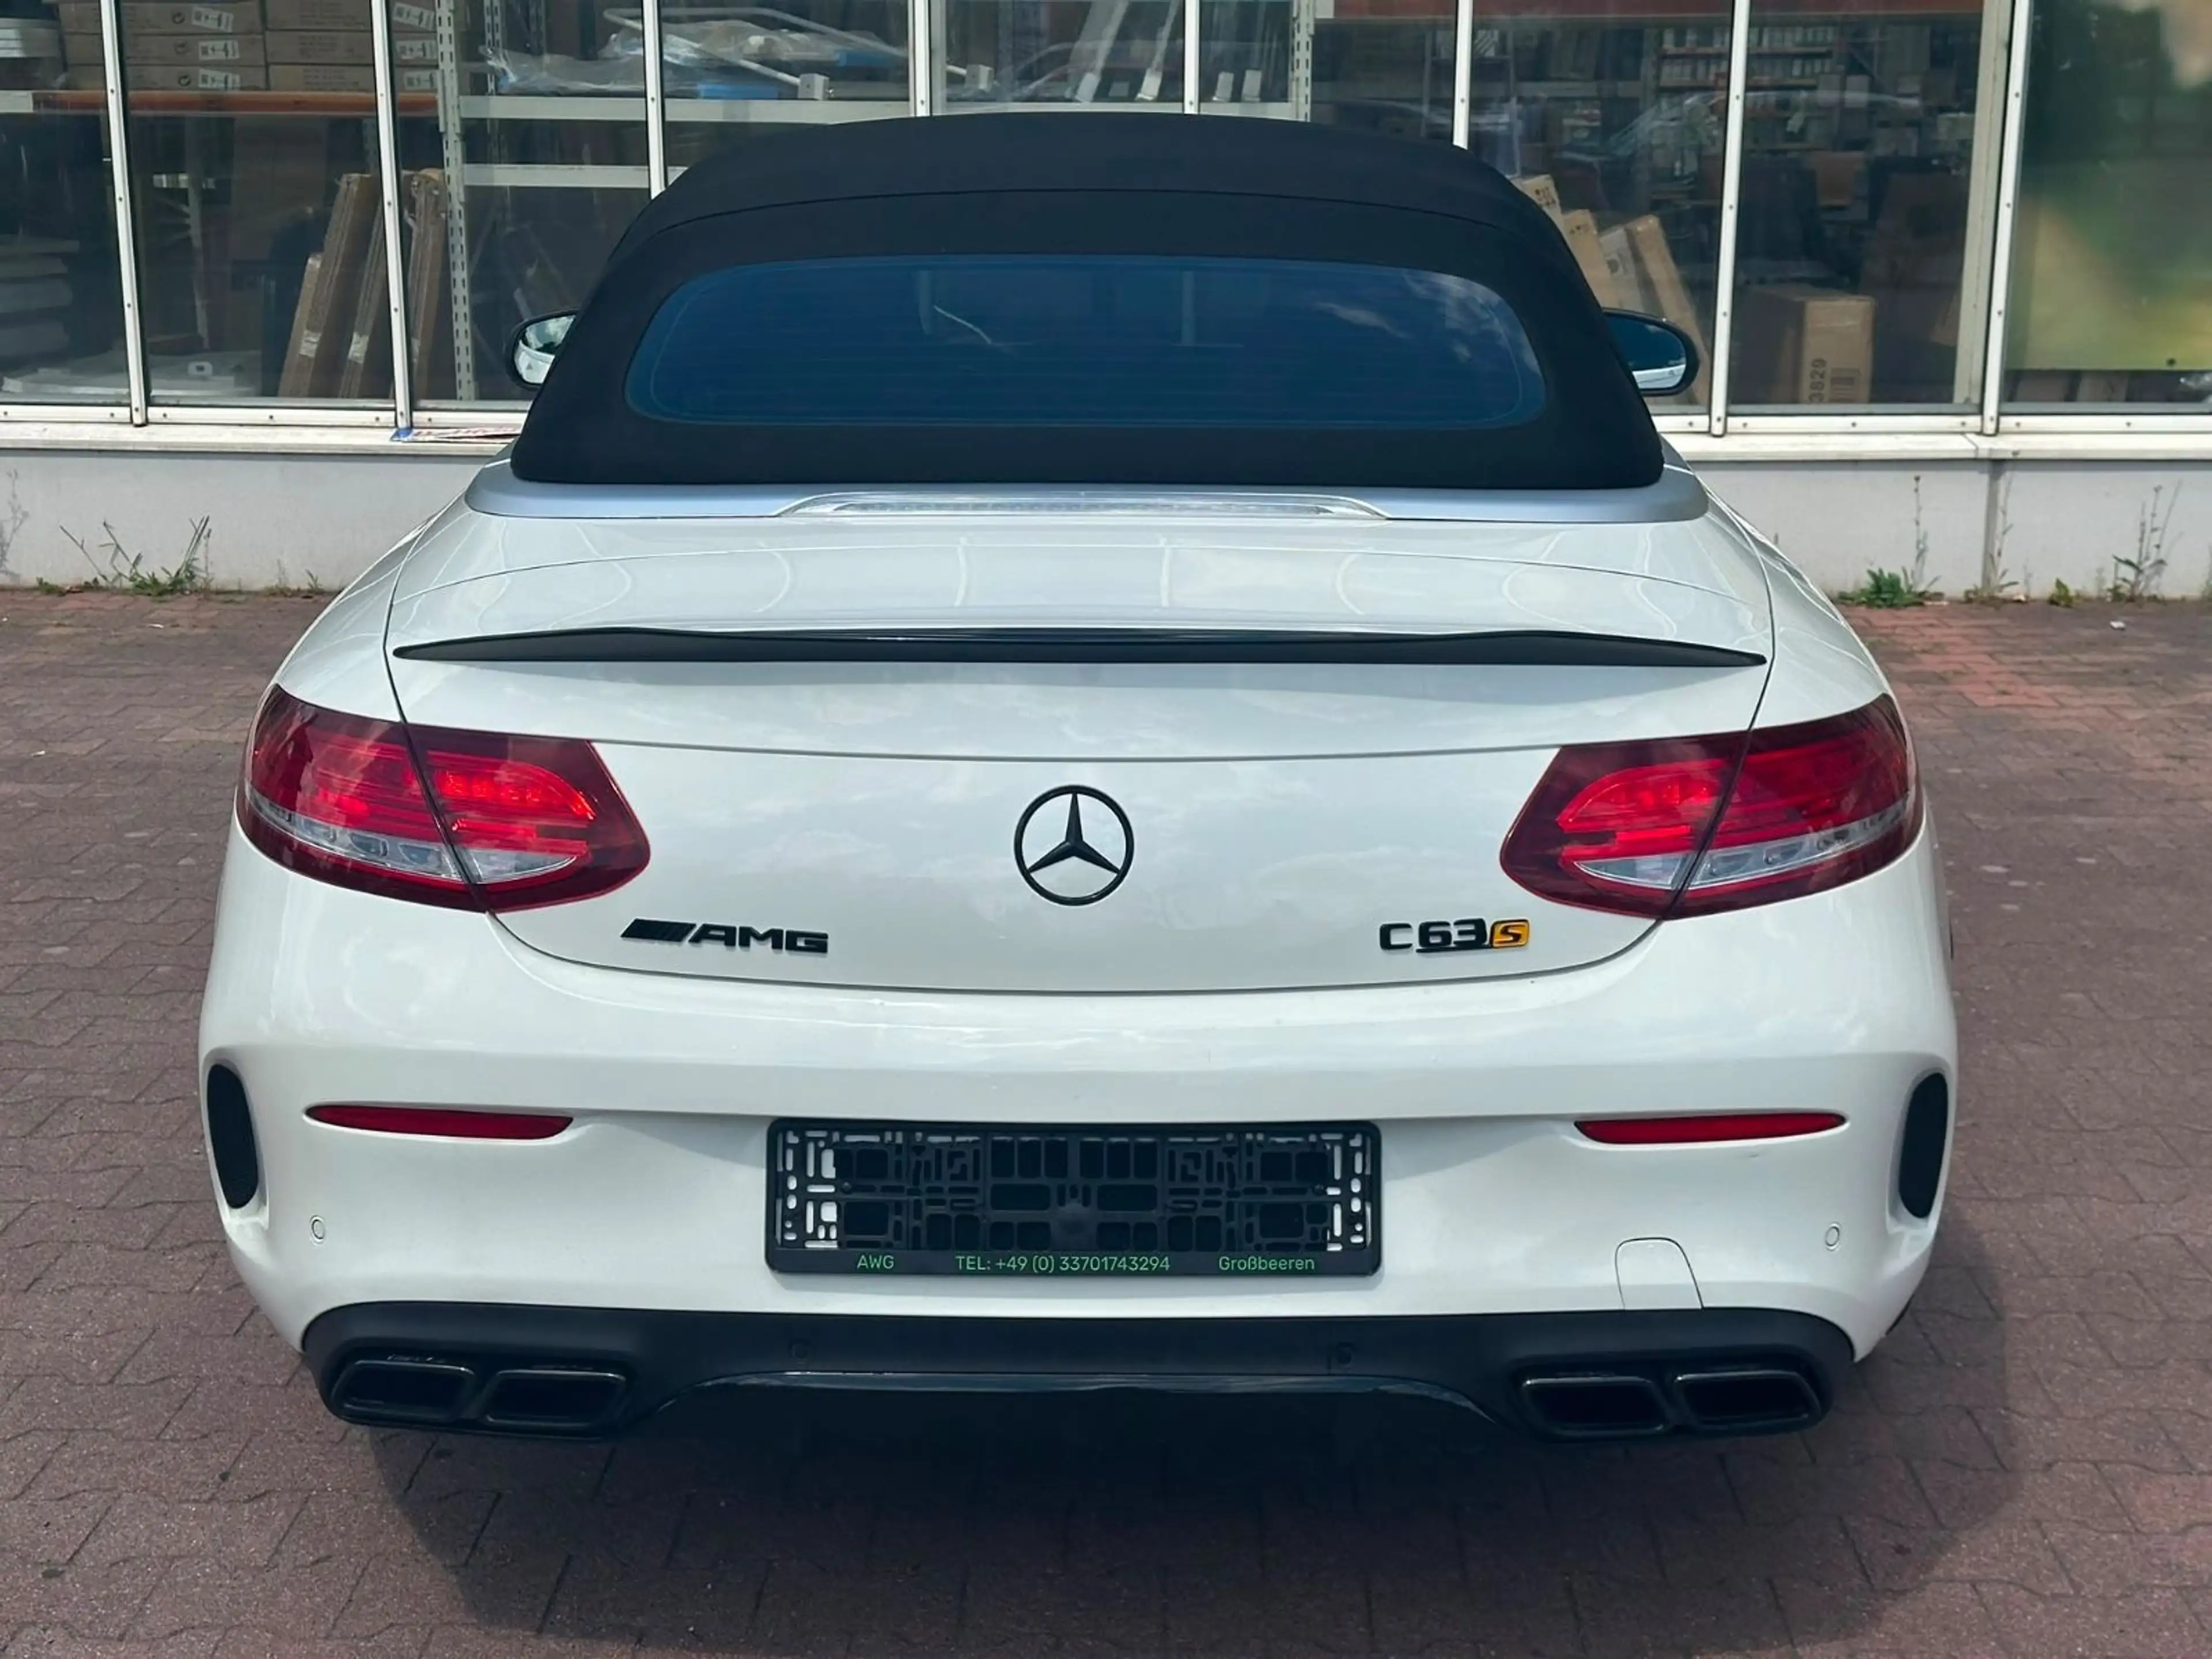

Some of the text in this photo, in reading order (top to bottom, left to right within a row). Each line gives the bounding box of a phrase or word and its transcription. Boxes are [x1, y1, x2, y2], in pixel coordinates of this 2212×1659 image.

[688, 923, 828, 953] AMG
[857, 1255, 1315, 1273] AWG TEL: +49 (0) 33701743294 Großbeeren
